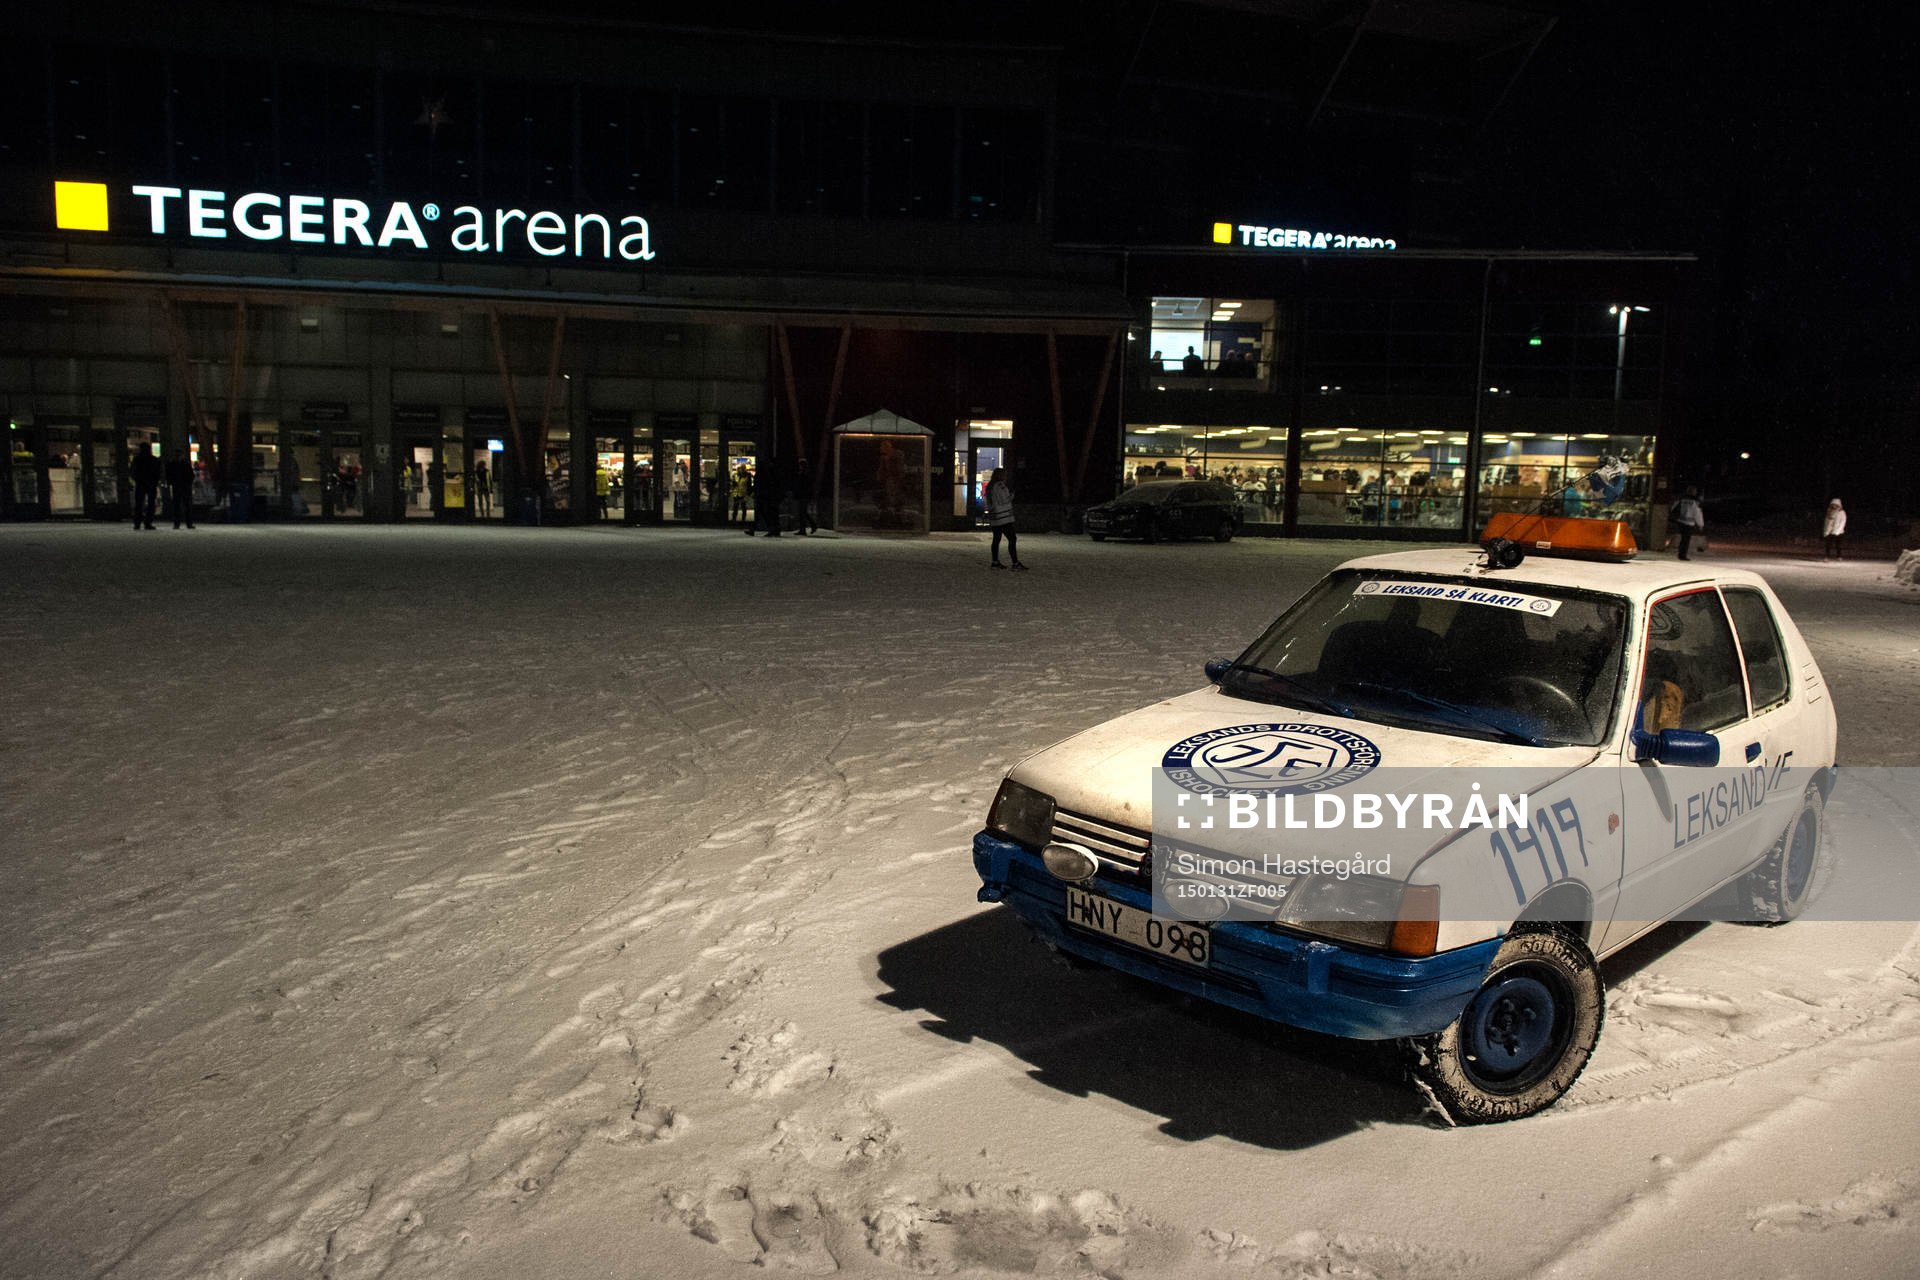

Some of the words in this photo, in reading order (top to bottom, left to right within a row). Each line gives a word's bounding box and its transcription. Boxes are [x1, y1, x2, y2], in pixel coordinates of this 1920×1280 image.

[451, 204, 656, 261] arena
[1382, 584, 1443, 597] LEKSAND
[1445, 587, 1468, 600] SÅ
[1468, 592, 1524, 608] KLART!
[1168, 724, 1271, 760] LEKSANDS
[1168, 768, 1281, 798] ISHOCKEY
[1674, 765, 1766, 849] LEKSAND
[1490, 797, 1589, 906] 1919
[1070, 891, 1123, 935] HNY
[1146, 918, 1207, 963] 098
